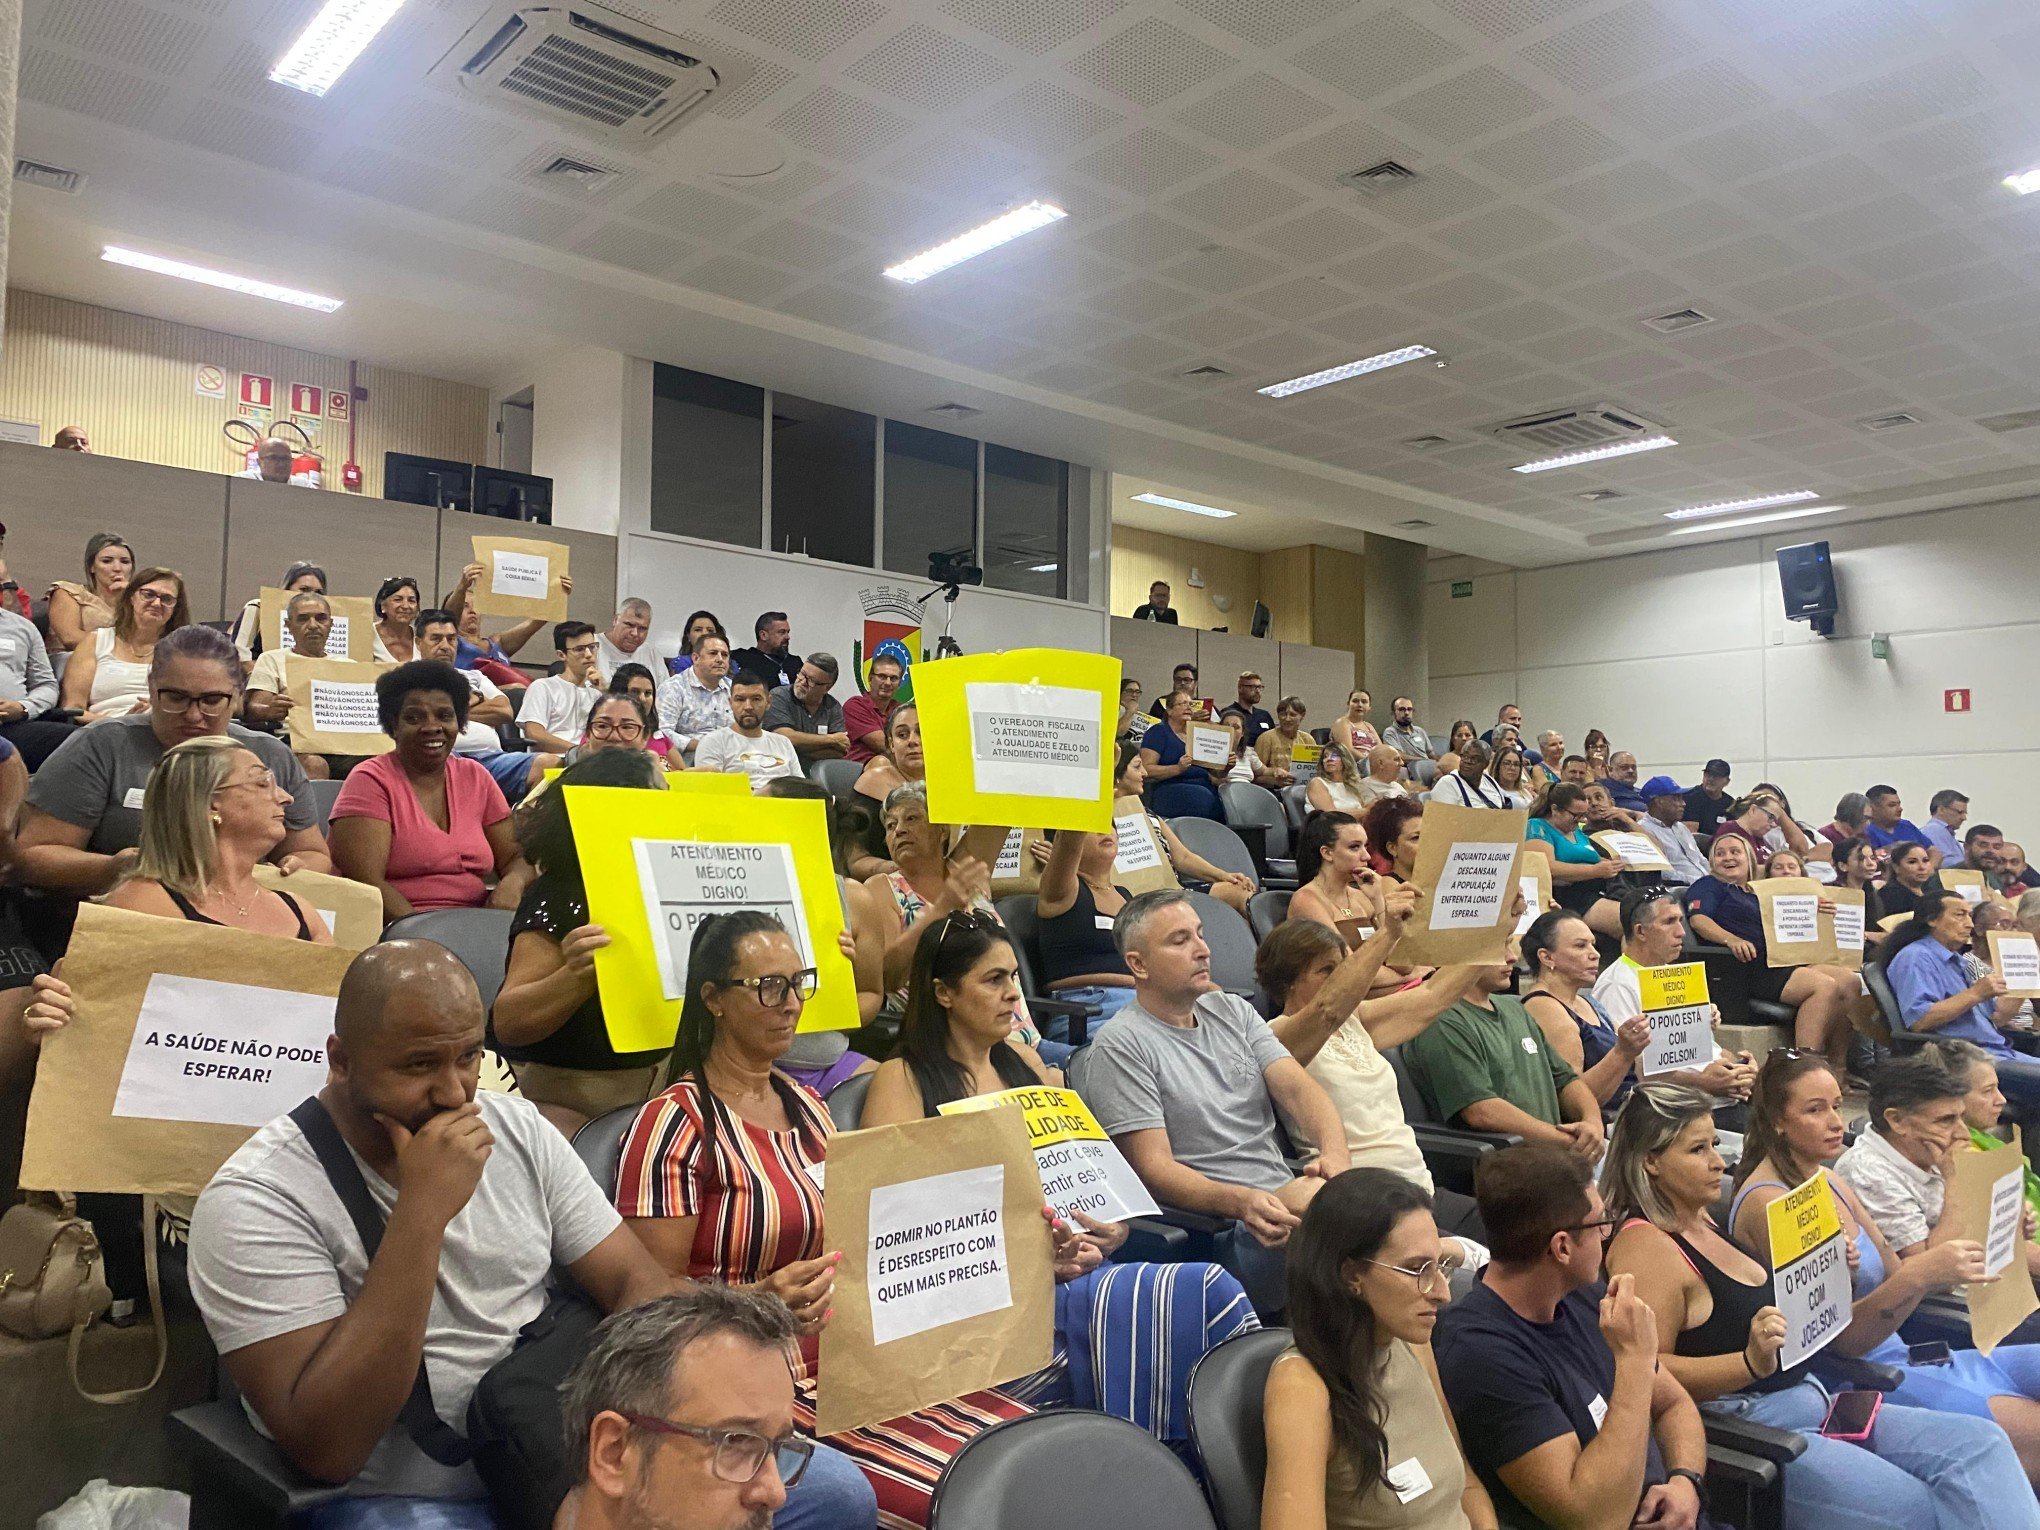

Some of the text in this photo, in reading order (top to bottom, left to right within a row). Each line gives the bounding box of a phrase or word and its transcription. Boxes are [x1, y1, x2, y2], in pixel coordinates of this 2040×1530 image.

[998, 718, 1044, 728] VEREADOR
[1048, 721, 1086, 732] FISCALIZA
[1002, 728, 1058, 740] ATENDIMENTO
[1004, 739, 1050, 750] QUALIDADE
[1059, 743, 1078, 752] ZELO
[992, 748, 1079, 762] ATENDIMENTO MÉDICO
[671, 846, 762, 861] ATENDIMENTO
[1453, 852, 1487, 861] ENQUANTO
[696, 863, 746, 880] MÉDICO
[1457, 867, 1498, 876] DESCANSAM,
[702, 885, 748, 899] DIGNO!
[1456, 880, 1496, 893] POPULAÇÃO
[1441, 895, 1498, 904] ENFRENTA LONGAS
[669, 912, 682, 930] O
[1451, 909, 1479, 918] ESPERAS.
[1653, 966, 1692, 979] ATENDIMENTO
[1663, 980, 1685, 992] MÉDICO
[1666, 994, 1686, 1006] DIGNO!
[1650, 1008, 1702, 1030] O POVO ESTÁ
[1669, 1031, 1686, 1046] COM
[145, 1032, 323, 1064] A SAÚDE NÃO PODE
[1658, 1048, 1697, 1066] JOELSON!
[183, 1062, 272, 1083] ESPERAR!
[1044, 1091, 1068, 1107] DE
[1785, 1179, 1821, 1213] ATENDIMENTO
[1797, 1204, 1818, 1229] MÉDICO
[875, 1208, 997, 1250] DORMIR NO PLANTÃO
[1801, 1225, 1821, 1249] DIGNO!
[879, 1235, 996, 1275] É DESRESPEITO COM
[1786, 1242, 1839, 1294] O POVO ESTÁ
[878, 1260, 1001, 1303] QUEM MAIS PRECISA.
[1808, 1282, 1826, 1311] COM
[1801, 1304, 1839, 1349] JOELSON!
